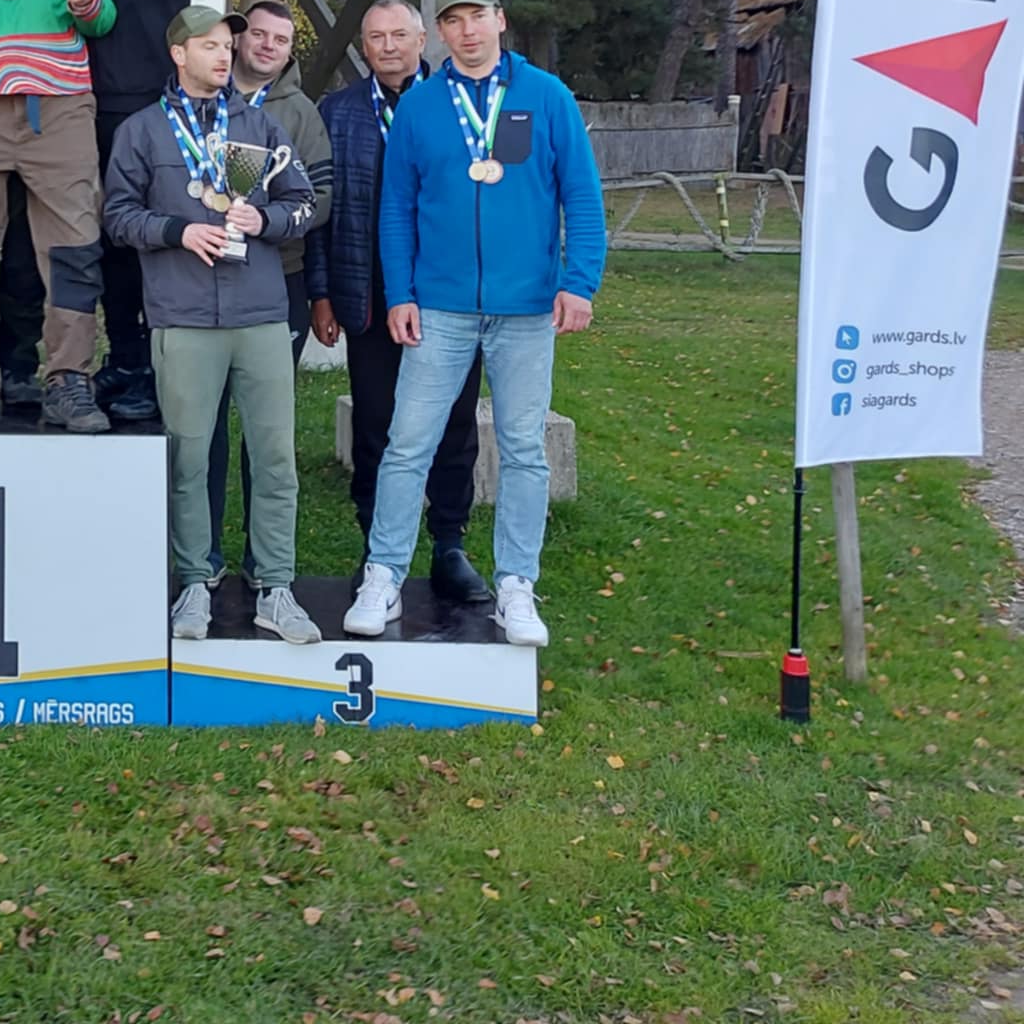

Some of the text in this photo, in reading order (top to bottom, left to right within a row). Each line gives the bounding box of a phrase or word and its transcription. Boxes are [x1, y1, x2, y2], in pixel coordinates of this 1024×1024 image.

[872, 330, 967, 346] www.gards.lv
[866, 360, 956, 380] gards_shops
[861, 393, 918, 410] siagards
[334, 652, 375, 724] 3
[33, 699, 134, 724] MĒRSRAGS
